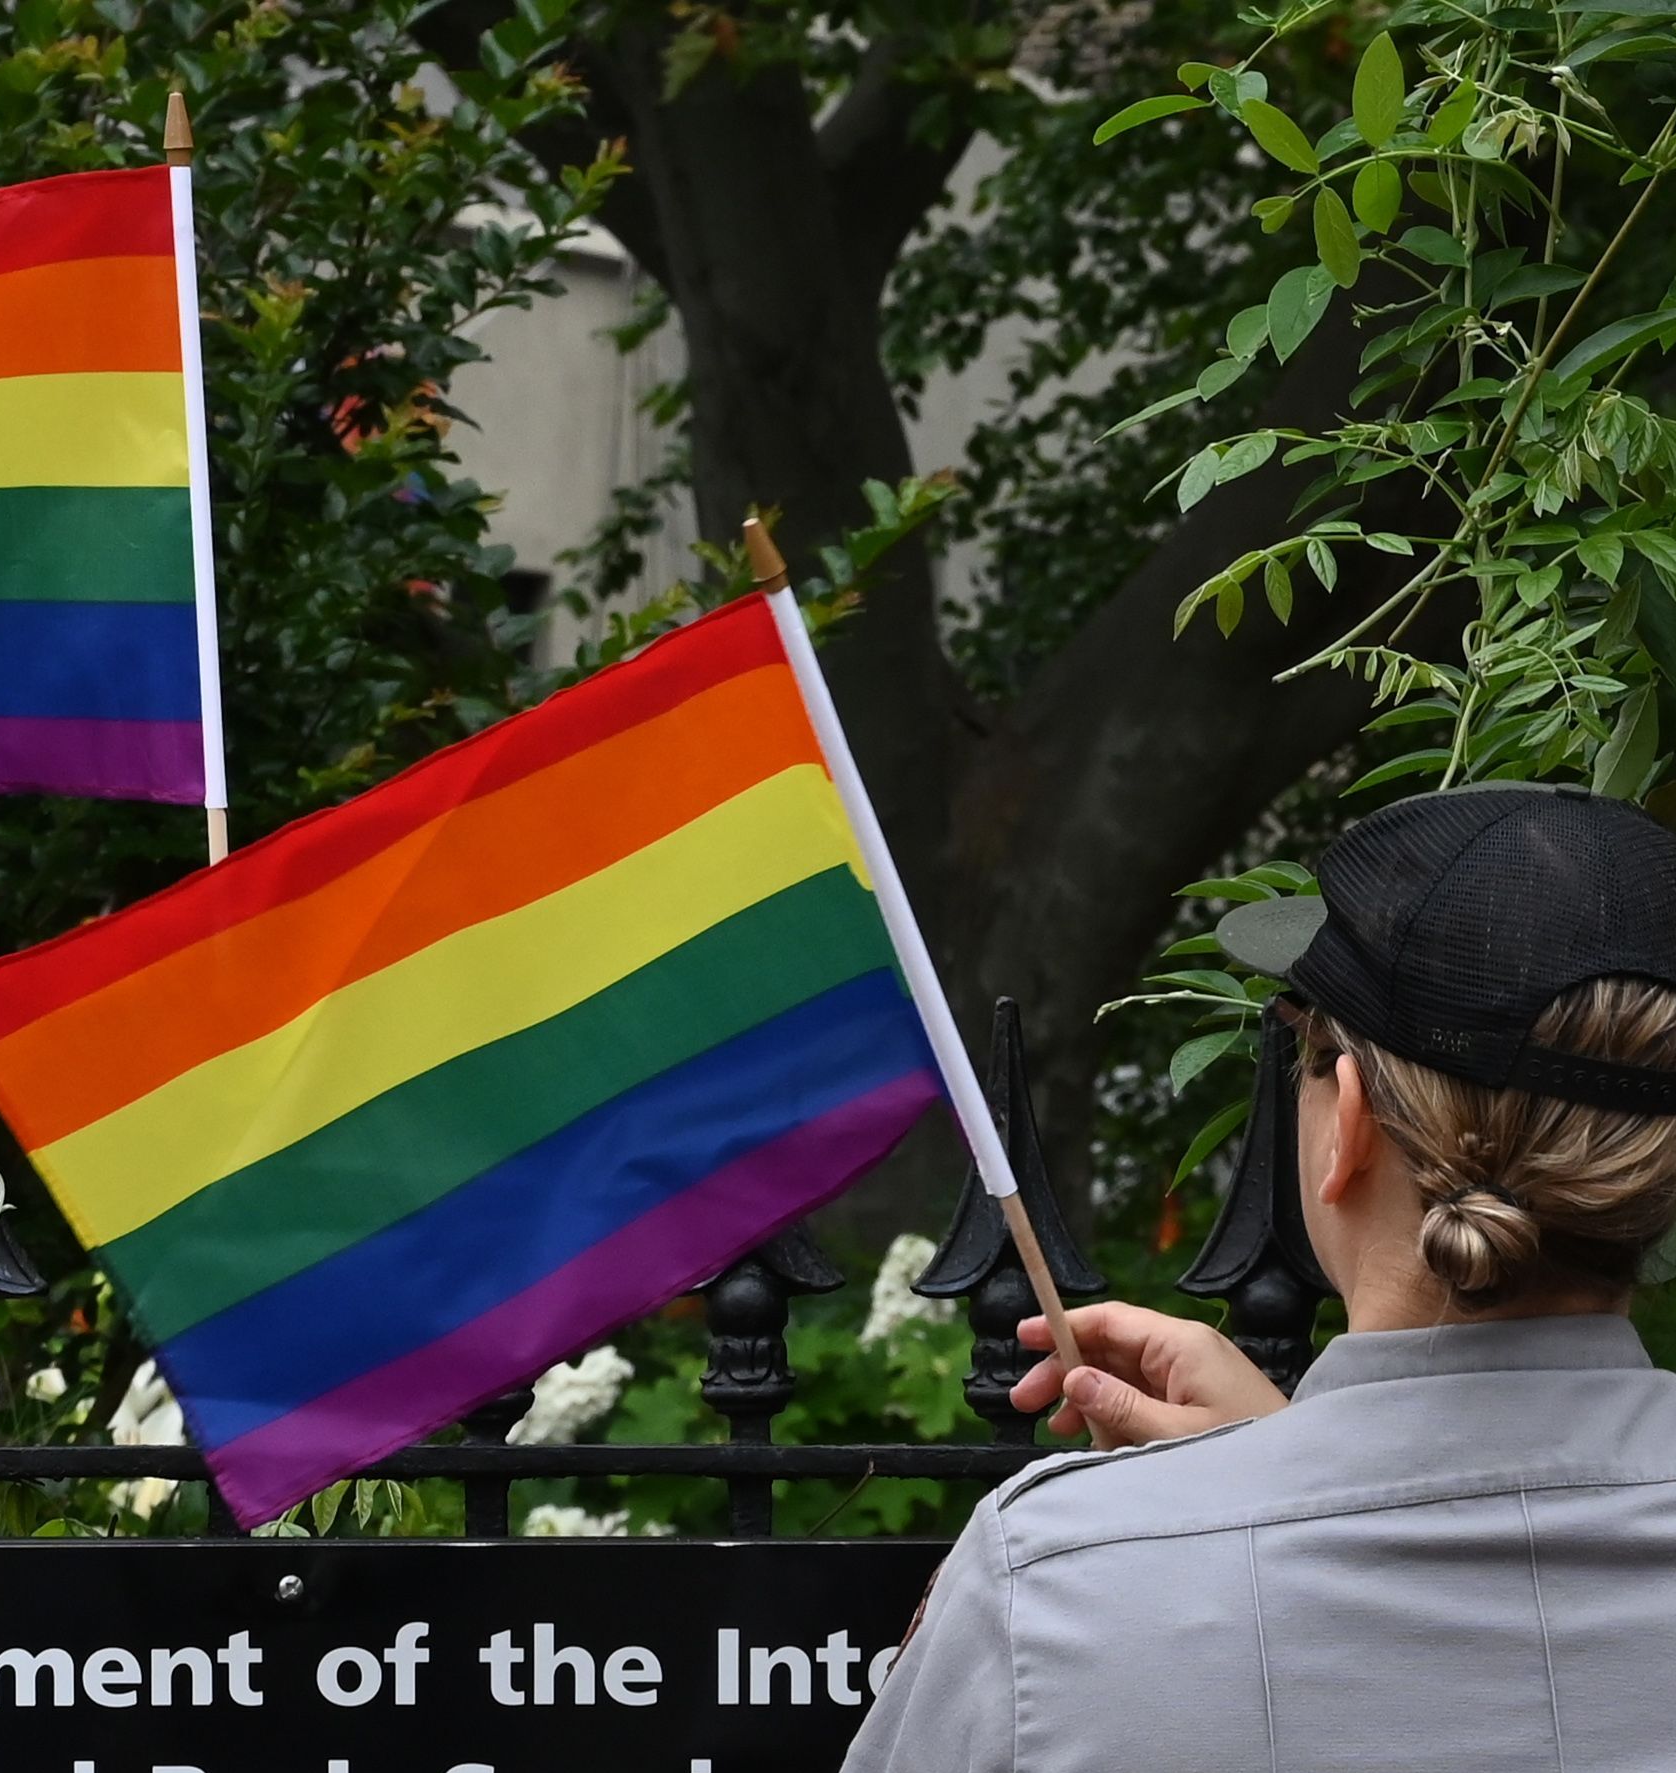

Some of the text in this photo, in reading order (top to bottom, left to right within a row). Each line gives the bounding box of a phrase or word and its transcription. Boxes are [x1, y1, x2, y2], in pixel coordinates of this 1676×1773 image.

[316, 1621, 431, 1708] of
[479, 1622, 664, 1707] the
[717, 1627, 901, 1706] Int
